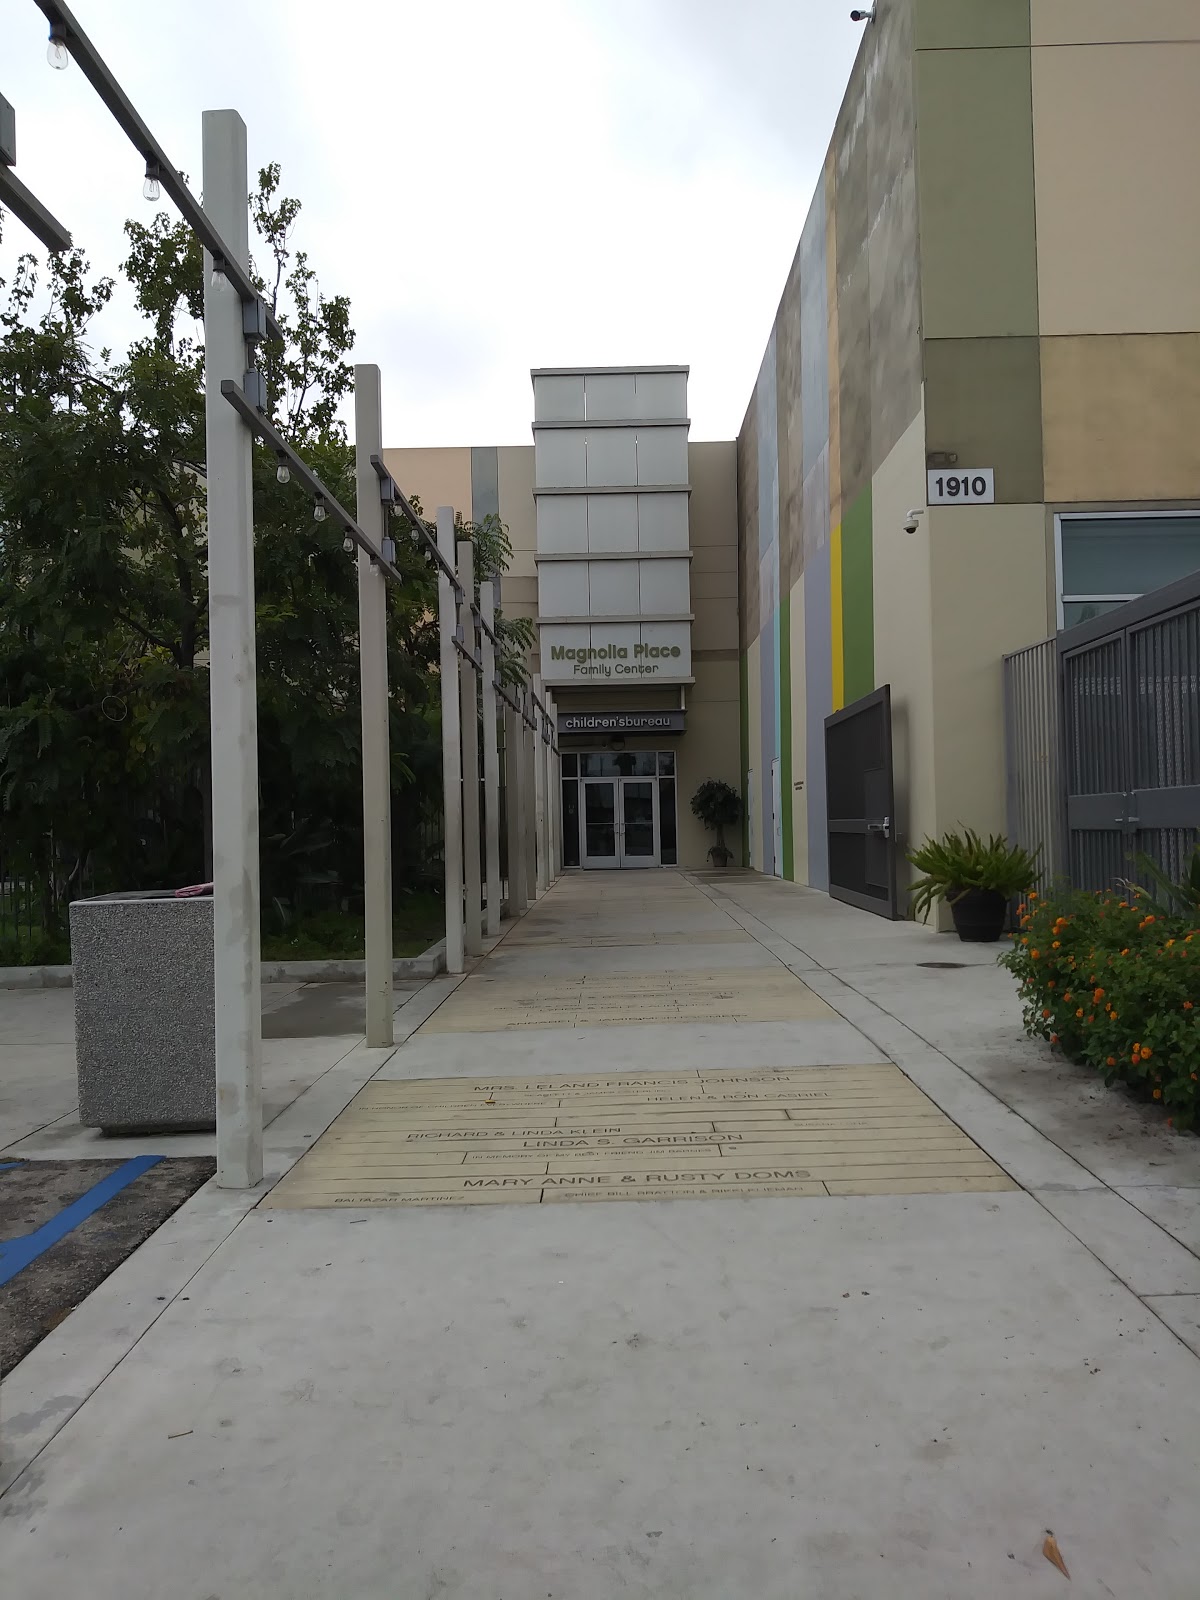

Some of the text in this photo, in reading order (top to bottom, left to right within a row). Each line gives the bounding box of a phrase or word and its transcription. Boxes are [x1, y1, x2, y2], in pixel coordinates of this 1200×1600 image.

[935, 476, 987, 497] 1910
[550, 642, 682, 664] Magnolia Place
[573, 662, 660, 677] Family Center
[606, 1078, 688, 1087] FRANCIS
[695, 1075, 791, 1084] JOHNSON
[407, 1131, 489, 1139] RICHARD
[511, 1129, 565, 1138] LINDA
[570, 1127, 622, 1135] KLEIN
[523, 1133, 744, 1148] LINDA S. GARRISON
[463, 1169, 812, 1187] MARY ANNE & RUSTY DOMS
